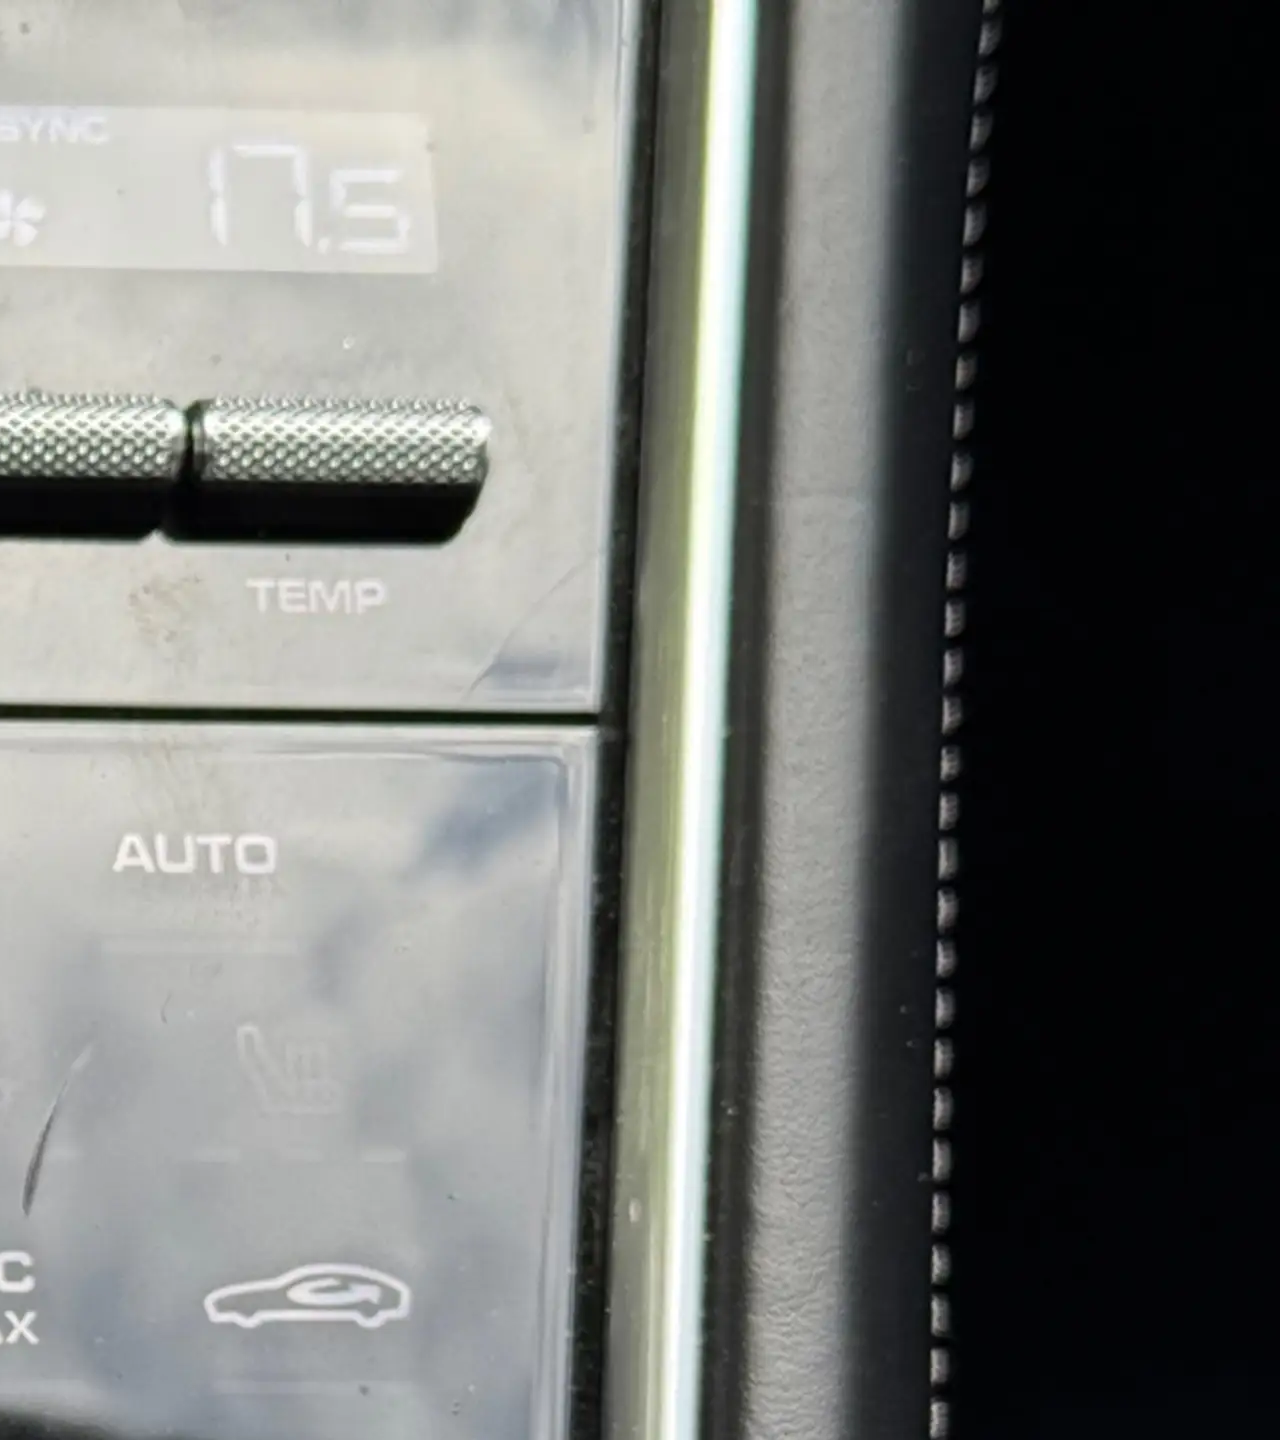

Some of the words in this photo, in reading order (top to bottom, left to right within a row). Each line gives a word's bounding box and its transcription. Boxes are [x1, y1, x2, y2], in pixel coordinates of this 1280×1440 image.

[207, 143, 412, 254] 17.5
[246, 577, 387, 614] TEMP
[112, 834, 278, 875] AUTO
